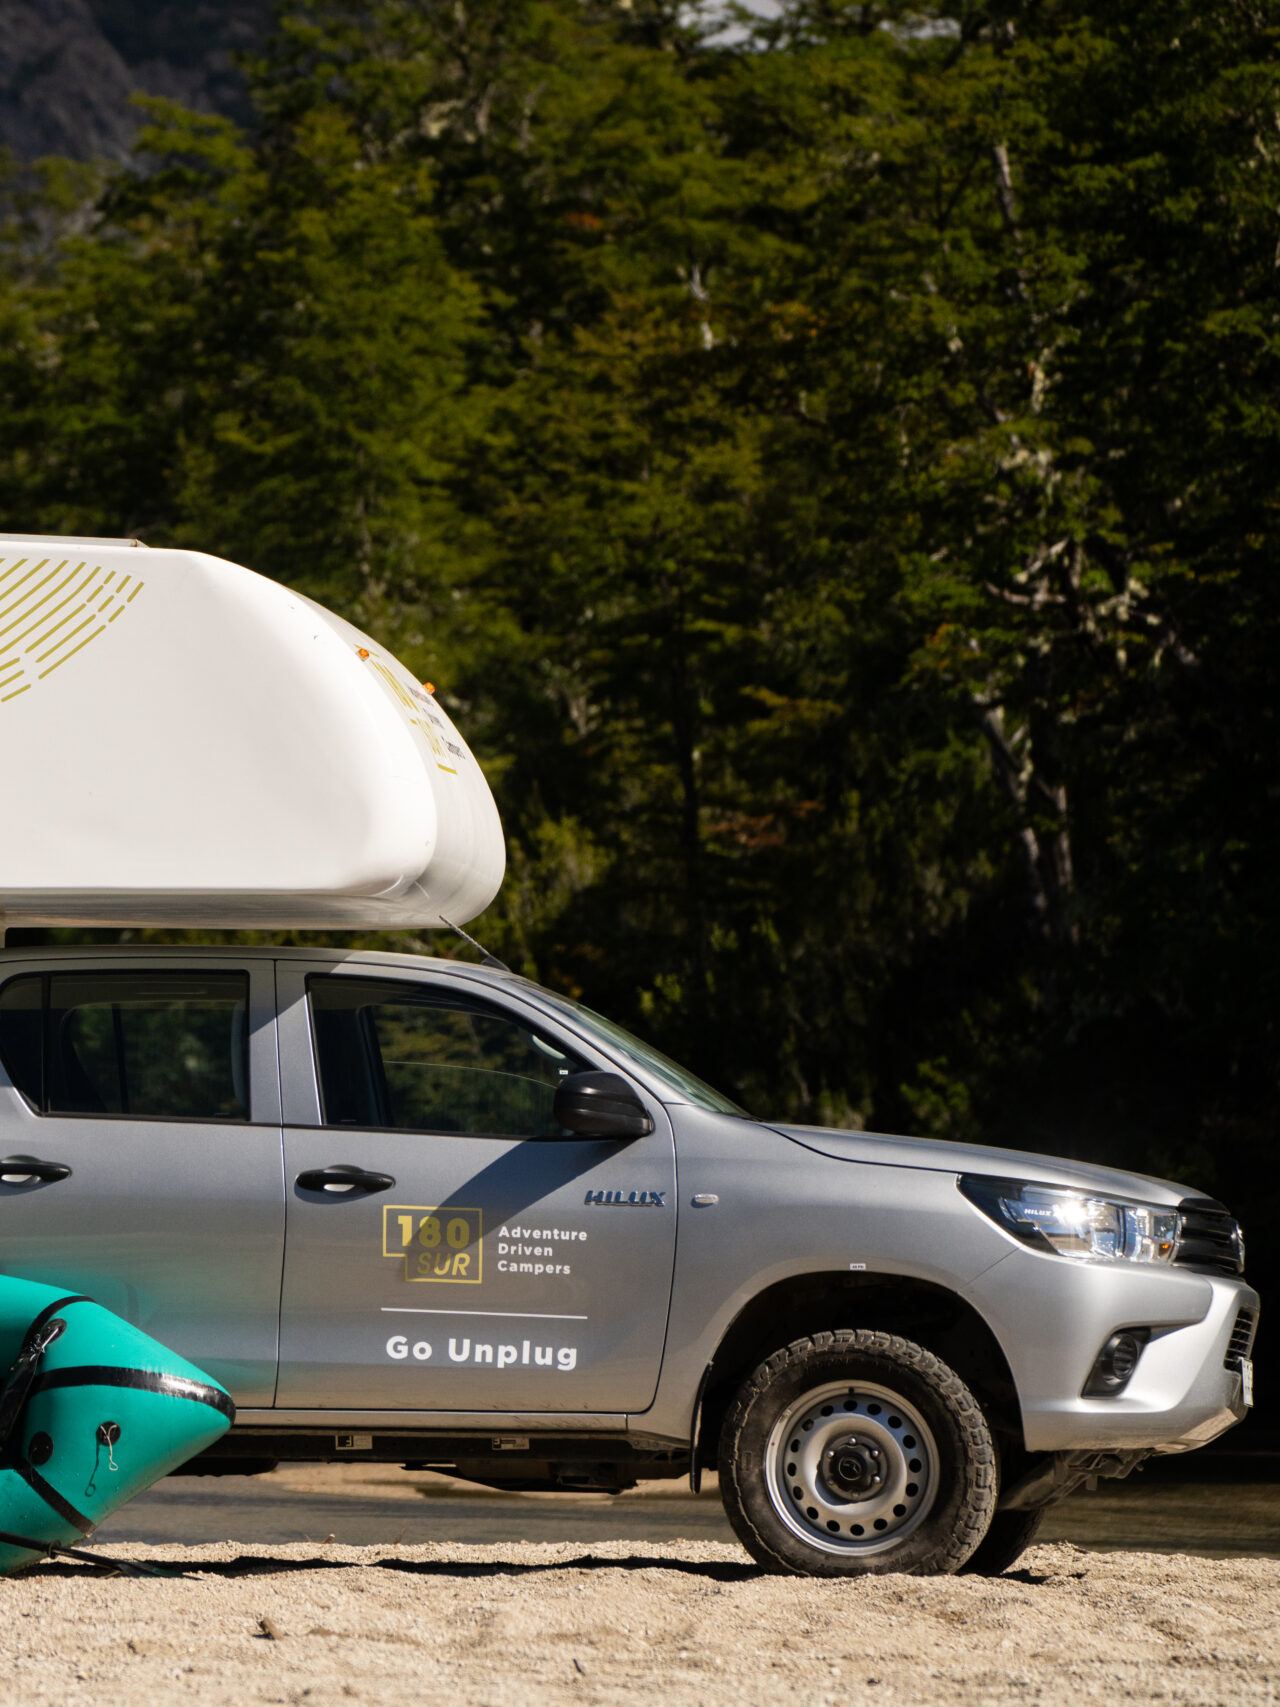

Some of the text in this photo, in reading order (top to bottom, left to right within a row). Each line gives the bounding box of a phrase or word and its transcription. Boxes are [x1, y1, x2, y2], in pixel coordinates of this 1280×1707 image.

[584, 1189, 666, 1207] HILUX
[397, 1214, 470, 1250] 180
[498, 1225, 588, 1241] Adventure
[498, 1242, 553, 1257] Driven
[416, 1251, 471, 1277] SUR
[497, 1259, 571, 1276] Campers
[385, 1335, 578, 1371] Go Unplug
